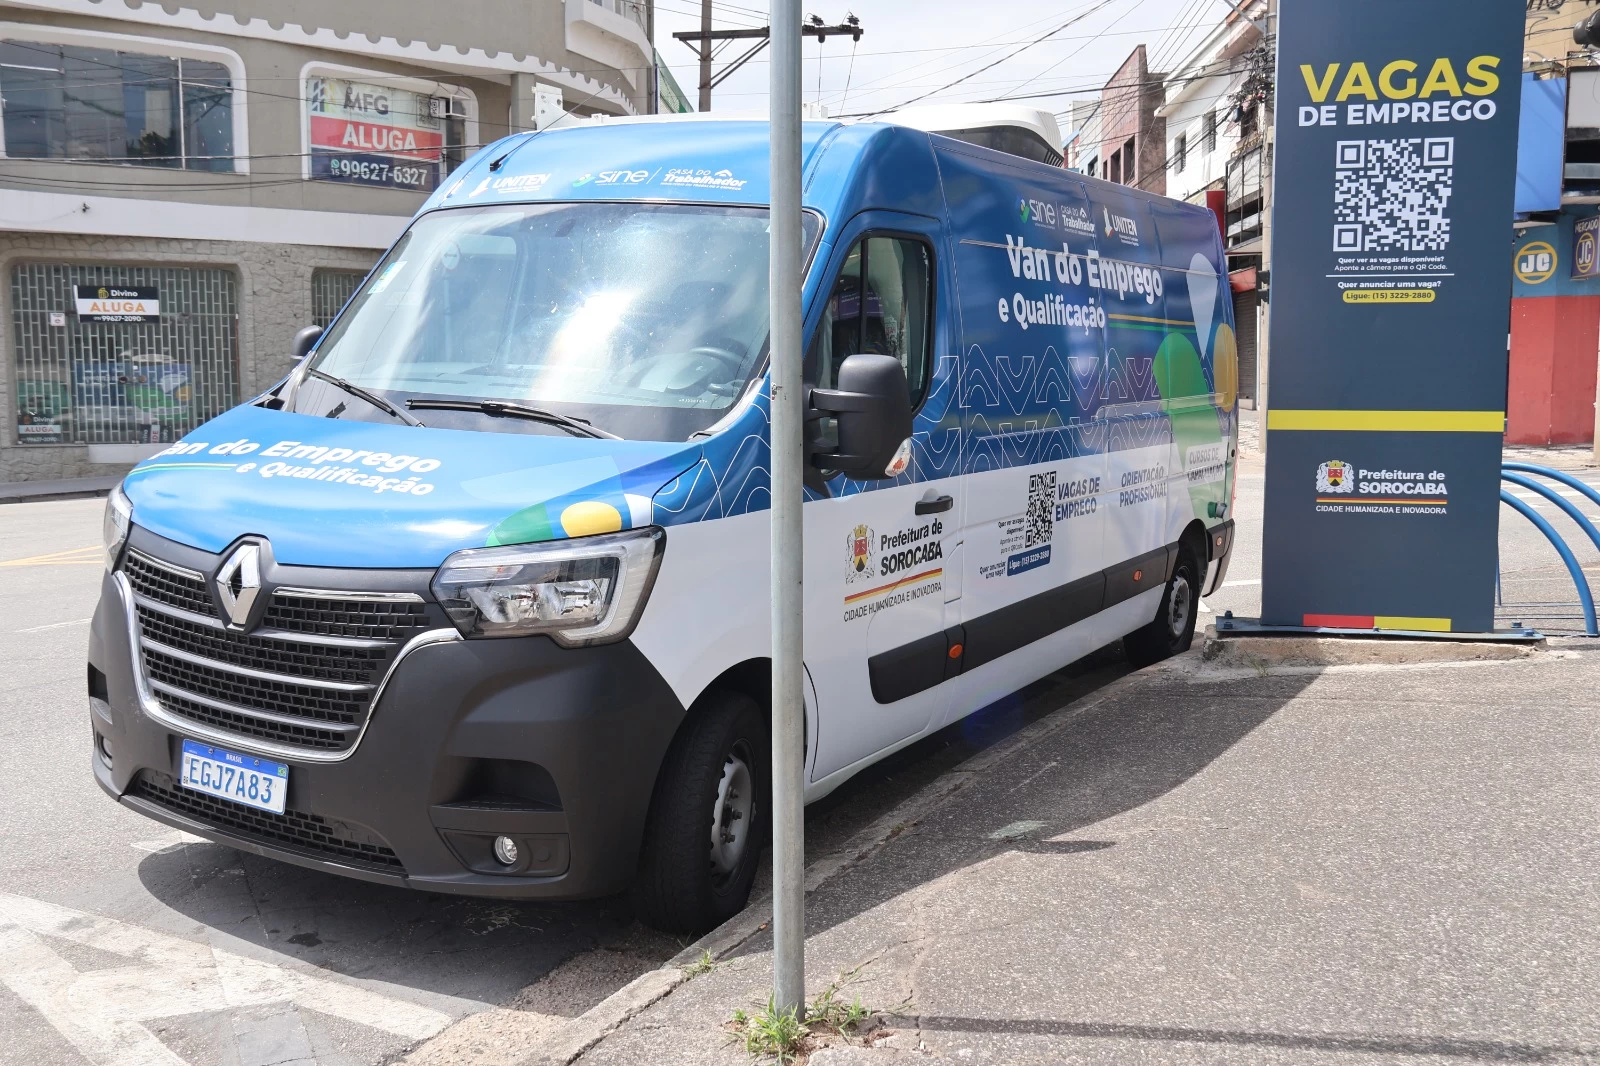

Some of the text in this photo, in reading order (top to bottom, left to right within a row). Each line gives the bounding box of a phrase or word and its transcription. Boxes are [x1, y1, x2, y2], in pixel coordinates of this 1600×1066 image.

[1299, 55, 1500, 102] VAGAS
[343, 89, 389, 115] MFG
[1298, 99, 1497, 127] DE EMPREGO
[342, 124, 418, 154] ALUGA
[340, 160, 428, 185] 99627-6327
[492, 173, 552, 189] UNITEN
[595, 168, 649, 183] sine
[663, 173, 748, 187] Trabalhador
[1029, 199, 1056, 225] sine
[1062, 214, 1095, 232] Trabalhador
[1111, 214, 1138, 236] UNITEN
[1575, 219, 1599, 234] MERCADO
[1401, 256, 1444, 264] disponíveis?
[1521, 253, 1550, 273] JC
[1578, 239, 1592, 264] JC
[1005, 234, 1163, 304] Van do Emprego
[110, 289, 138, 297] Divino
[1337, 281, 1357, 289] Quer
[1417, 281, 1441, 289] vaga?
[1372, 292, 1388, 300] (15)
[90, 301, 146, 313] ALUGA
[998, 292, 1105, 336] e Qualificação
[208, 438, 261, 456] do
[258, 440, 441, 473] Emprego
[236, 461, 434, 495] e Qualificação
[1358, 469, 1445, 480] Prefeitura de
[1058, 477, 1100, 500] VAGAS DE
[1119, 482, 1167, 507] PROFISSIONAL
[1358, 482, 1448, 495] SOROCABA
[1056, 497, 1097, 521] EMPREGO
[880, 518, 943, 551] Prefeitura de
[880, 540, 943, 576] SOROCABA
[843, 581, 942, 622] CIDADE HUMANIZADA E INOVADORA
[225, 753, 243, 764] BRASIL
[189, 758, 273, 804] EGJ7A83
